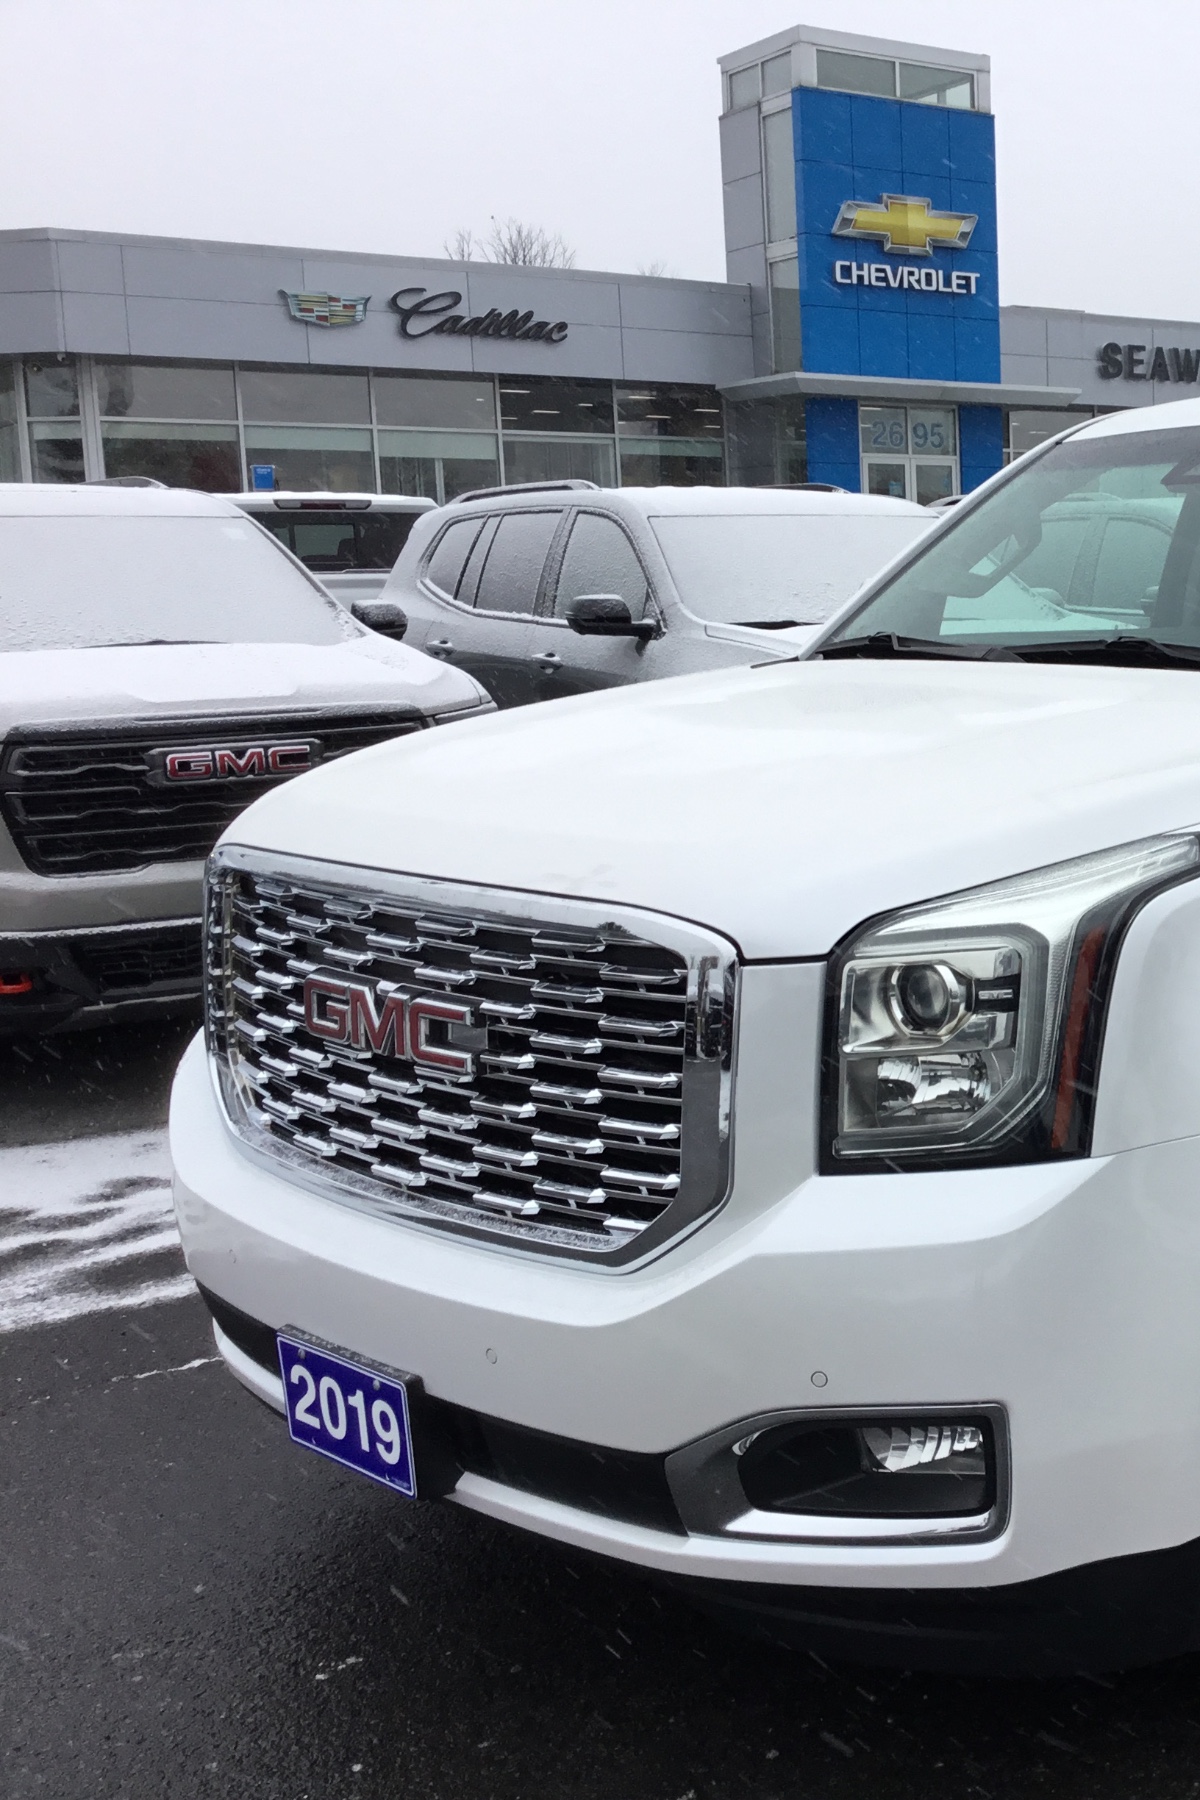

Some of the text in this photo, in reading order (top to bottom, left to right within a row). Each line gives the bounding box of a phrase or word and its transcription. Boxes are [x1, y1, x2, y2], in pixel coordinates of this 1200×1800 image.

[835, 260, 980, 294] CHEVROLET
[389, 287, 568, 343] Cadillac
[166, 745, 312, 782] GMC
[304, 971, 474, 1076] GMC
[290, 1364, 401, 1465] 2019
